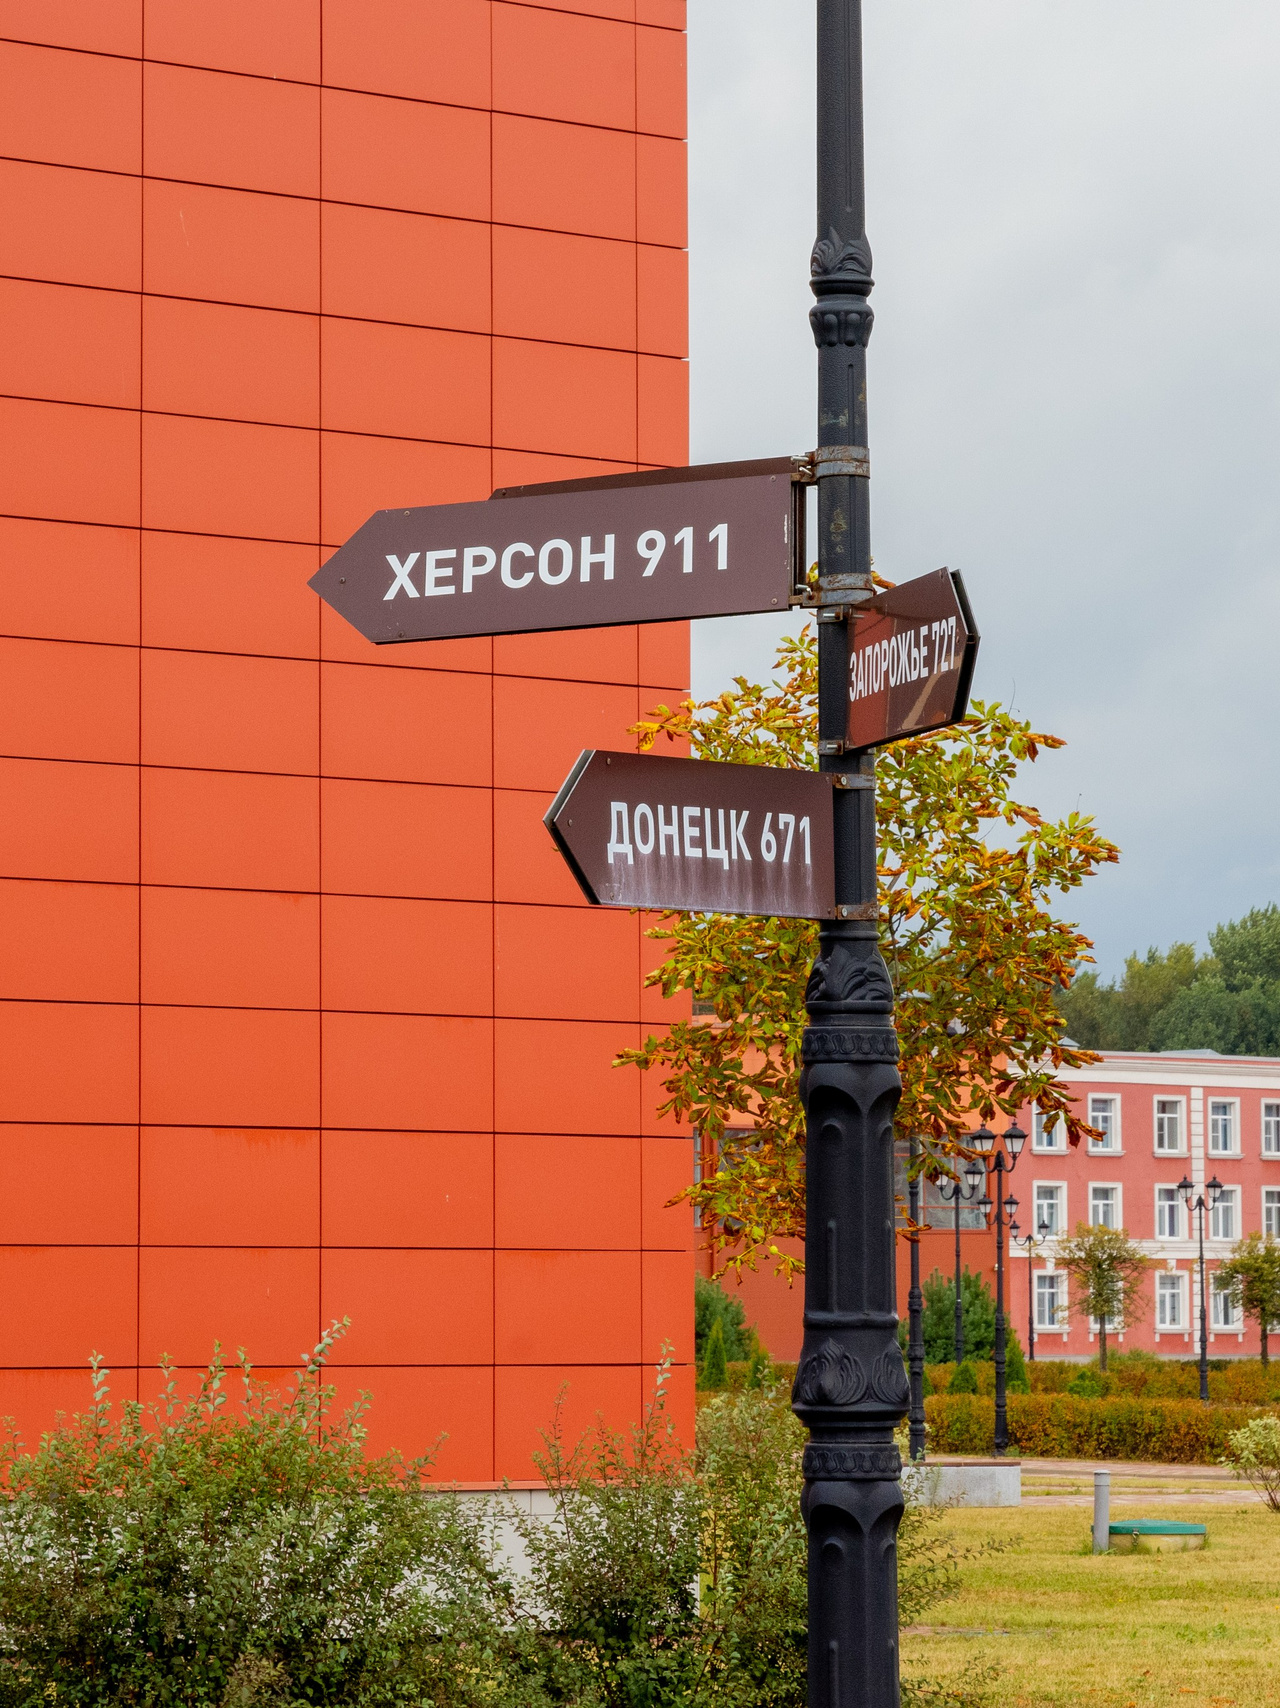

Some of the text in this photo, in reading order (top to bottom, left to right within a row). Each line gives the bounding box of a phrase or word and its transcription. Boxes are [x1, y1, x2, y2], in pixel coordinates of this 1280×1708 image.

[383, 523, 728, 601] ХЕРСОН 911
[849, 615, 957, 702] ЗАПОРОЖЬЕ 727
[607, 801, 812, 870] ДОНЕЦК 671
